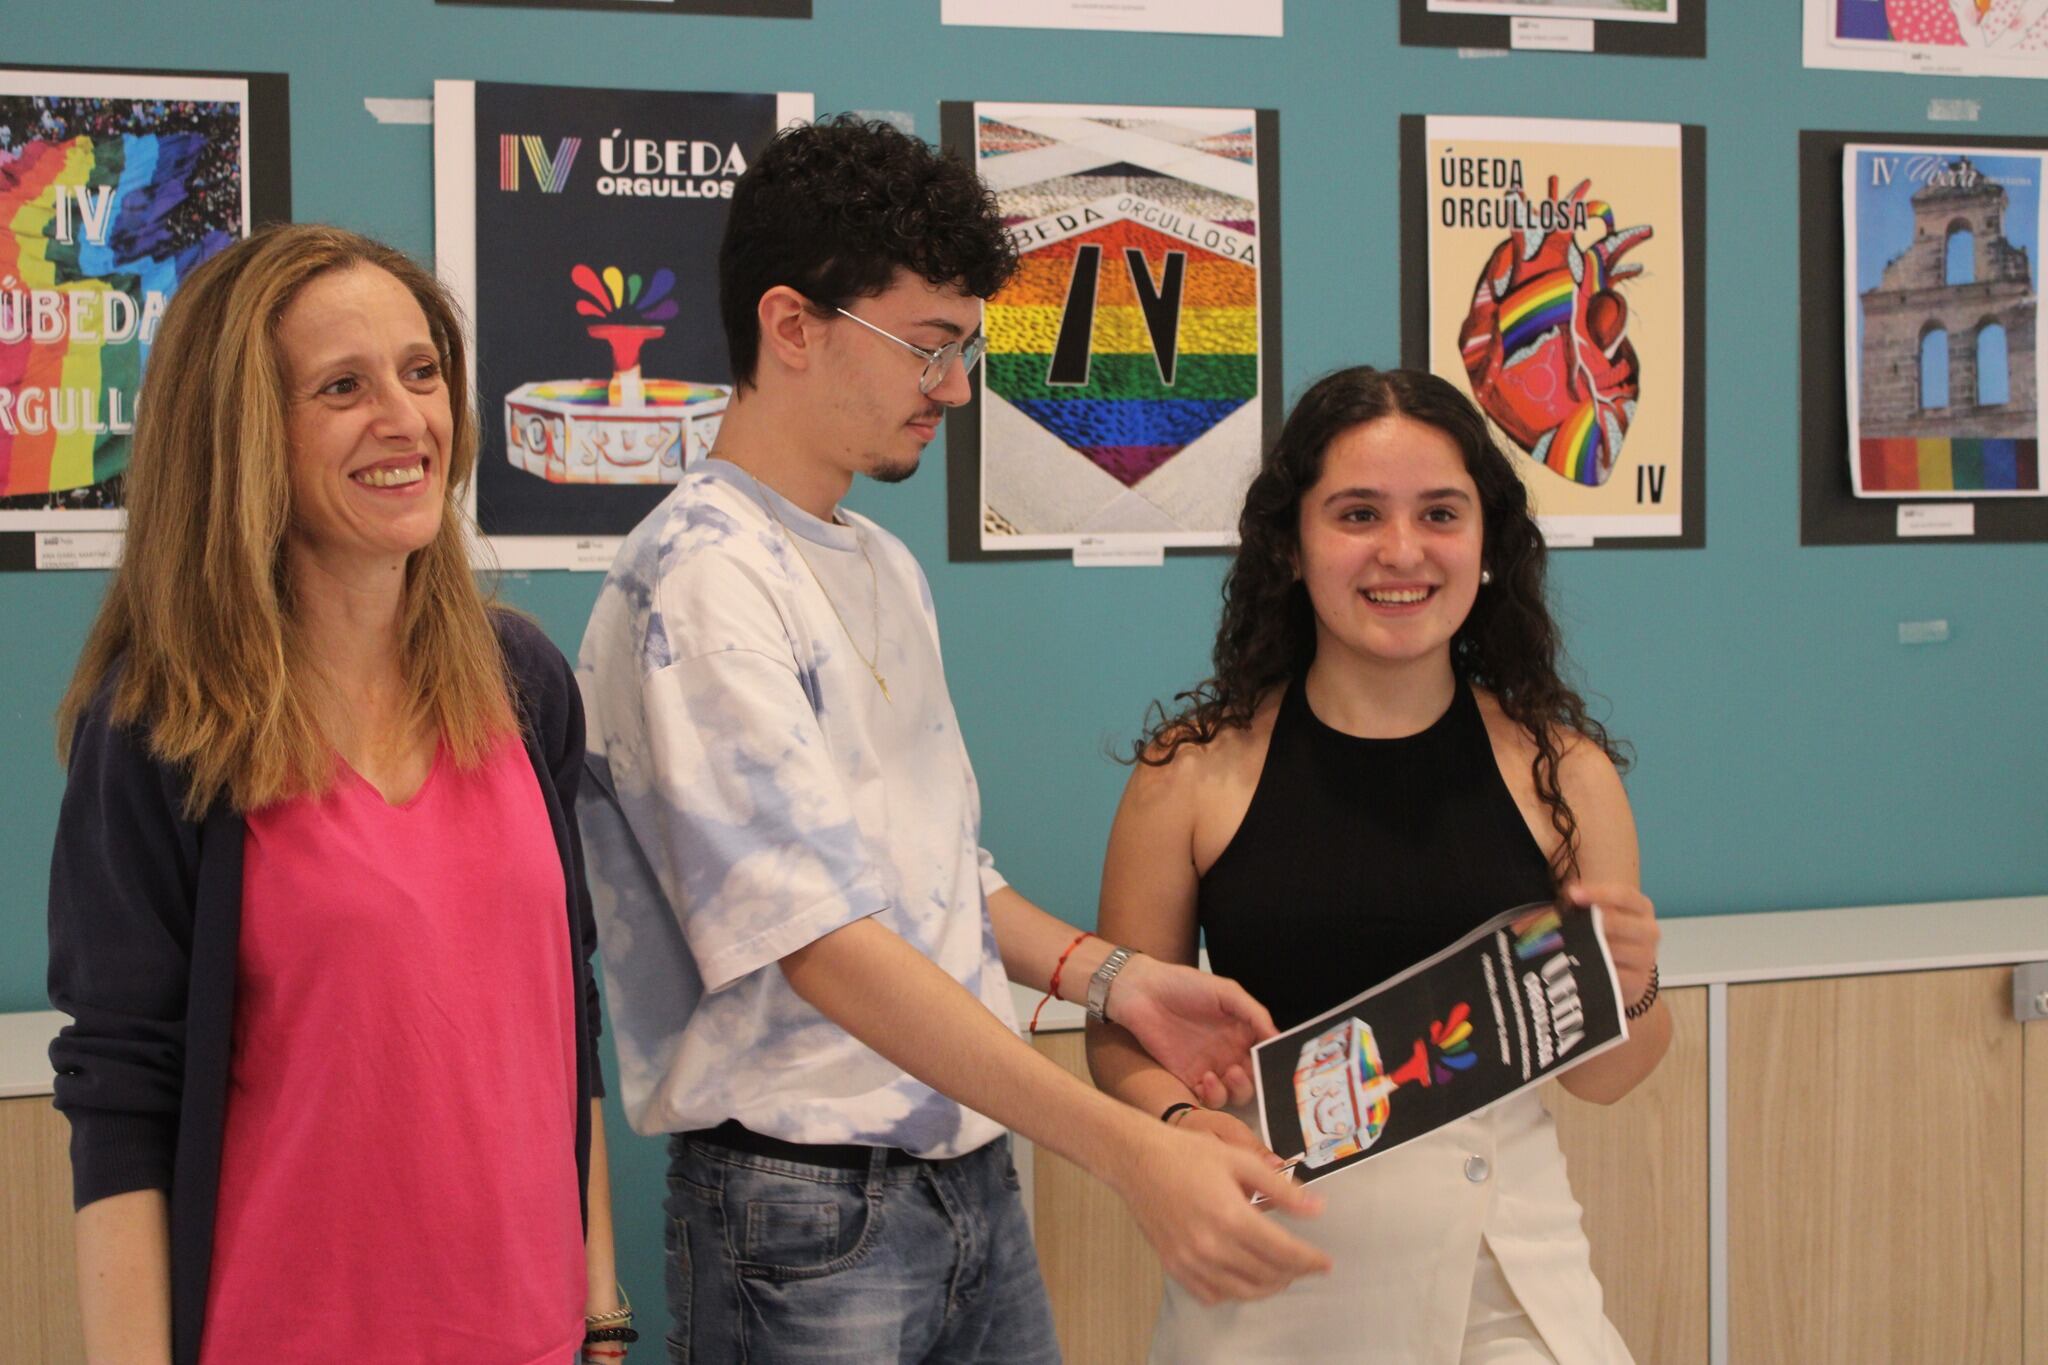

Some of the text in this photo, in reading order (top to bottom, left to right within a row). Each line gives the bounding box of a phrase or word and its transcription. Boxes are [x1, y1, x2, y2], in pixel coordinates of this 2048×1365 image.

[500, 128, 748, 194] IV ÚBEDA
[1441, 147, 1524, 188] ÚBEDA
[1872, 156, 1899, 187] IV
[54, 184, 117, 246] IV
[1012, 197, 1256, 265] BEDA ORGULLOSA
[1442, 197, 1588, 231] ORGULLOSA
[1046, 242, 1188, 387] IV
[1637, 464, 1666, 504] IV
